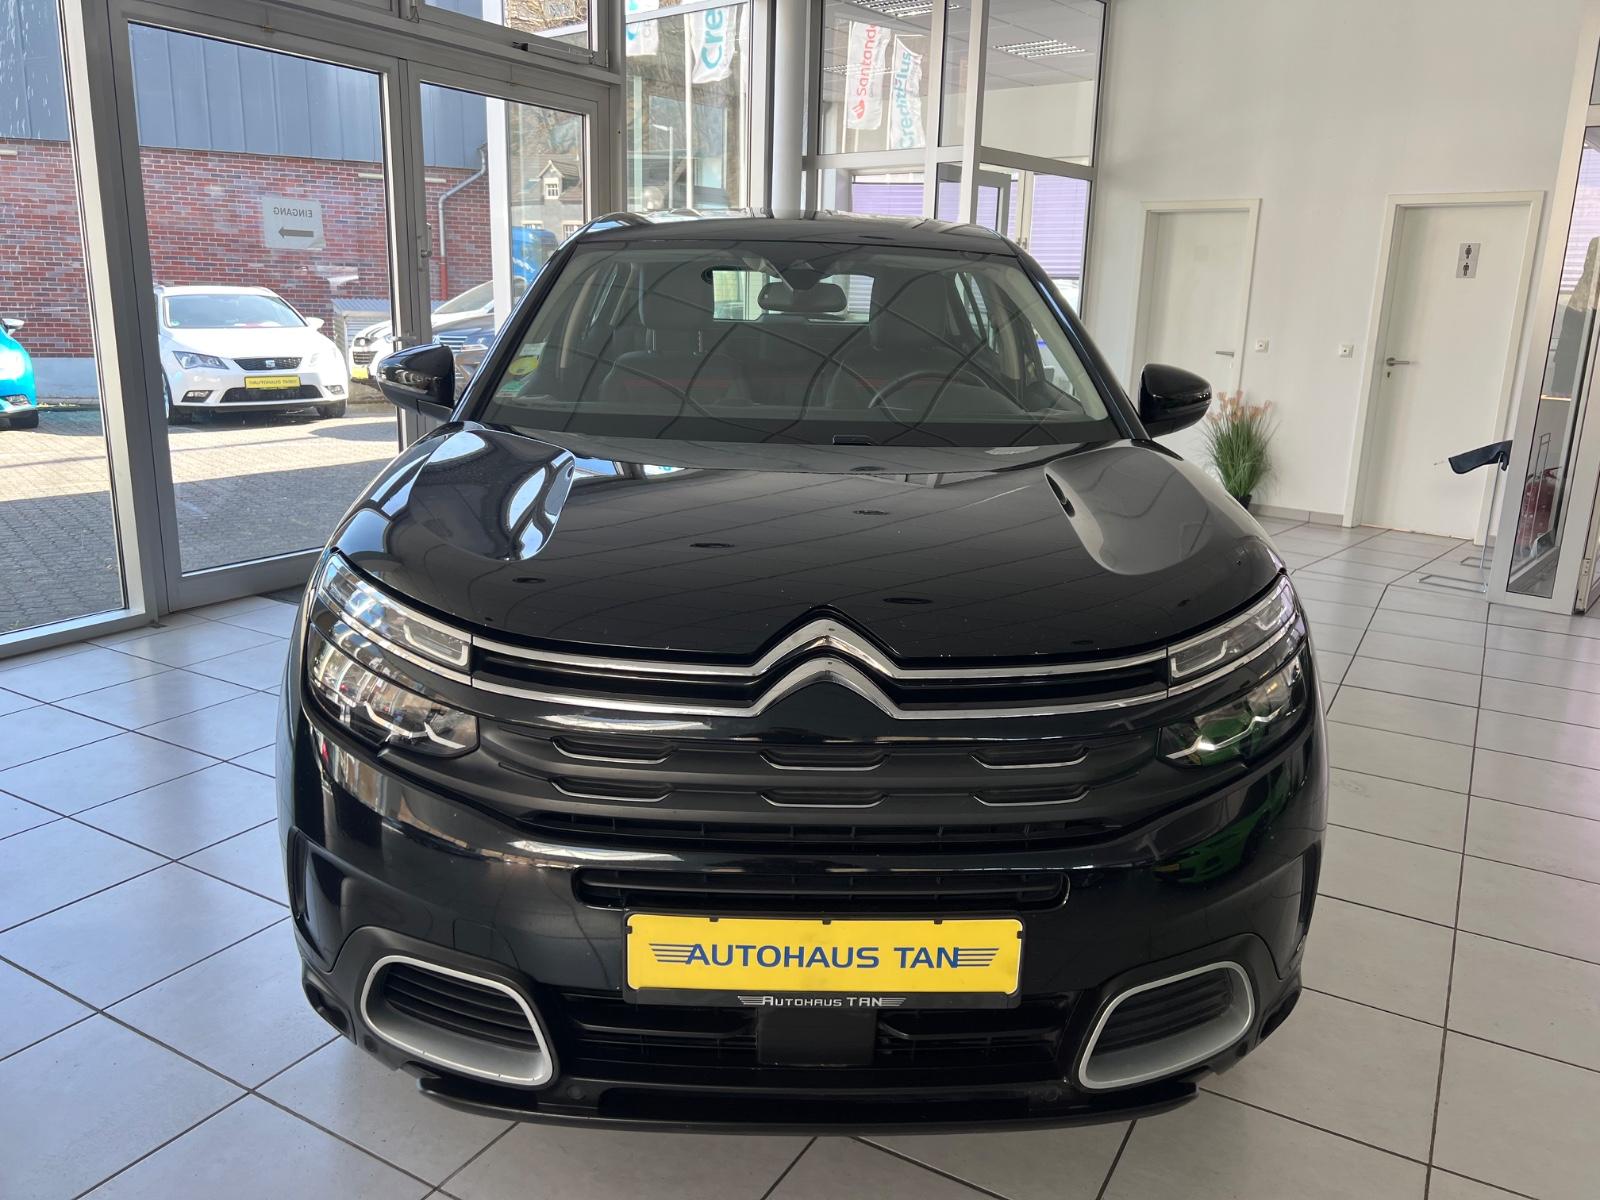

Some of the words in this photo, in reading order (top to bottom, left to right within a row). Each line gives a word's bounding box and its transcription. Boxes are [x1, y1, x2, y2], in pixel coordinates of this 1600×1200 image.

[685, 943, 880, 969] AUTOHAUS
[893, 946, 960, 969] TAN
[762, 995, 842, 1007] AUTOHAUS
[846, 997, 883, 1007] TAN
